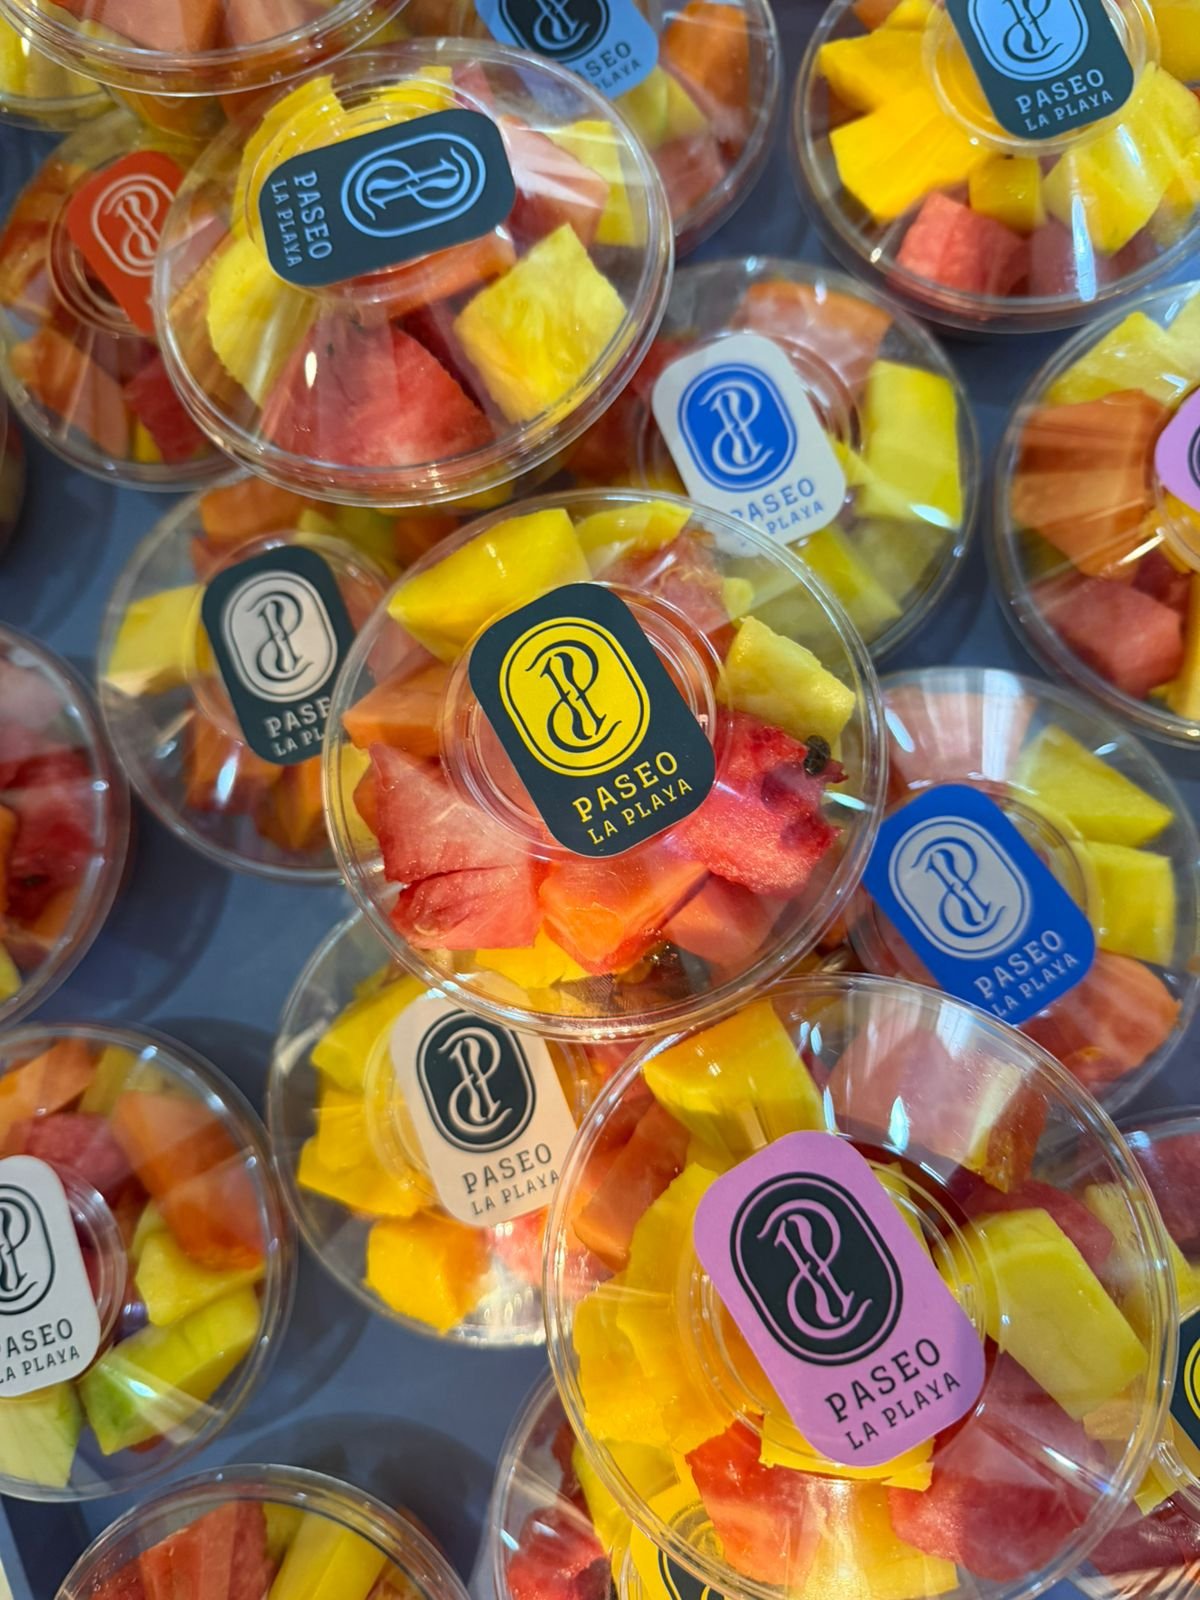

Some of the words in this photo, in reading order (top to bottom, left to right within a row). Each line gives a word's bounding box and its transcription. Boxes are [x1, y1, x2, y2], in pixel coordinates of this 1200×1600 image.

[573, 41, 632, 80] SEO
[595, 58, 642, 90] LAYA
[1015, 68, 1105, 115] PASEO
[1023, 113, 1049, 132] LA
[1054, 89, 1114, 121] PLAYA
[271, 180, 290, 206] LA
[293, 170, 333, 260] PASEO
[277, 208, 304, 268] PLAYA
[766, 500, 824, 535] PLAYA
[264, 696, 331, 738] PASE
[272, 737, 299, 757] LA
[572, 751, 678, 823] PASEO
[587, 819, 618, 844] LA
[621, 778, 693, 826] PLAYA
[973, 929, 1061, 999] PASEO
[991, 994, 1019, 1018] LA
[1018, 952, 1079, 999] PLAYA
[461, 1142, 552, 1194] PASEO
[471, 1196, 496, 1217] LA
[501, 1169, 560, 1204] PLAYA
[0, 1317, 73, 1358] ASEO
[21, 1345, 80, 1376] PLAYA
[824, 1338, 940, 1424] PASEO
[844, 1420, 879, 1450] LA
[881, 1371, 961, 1428] PLAYA
